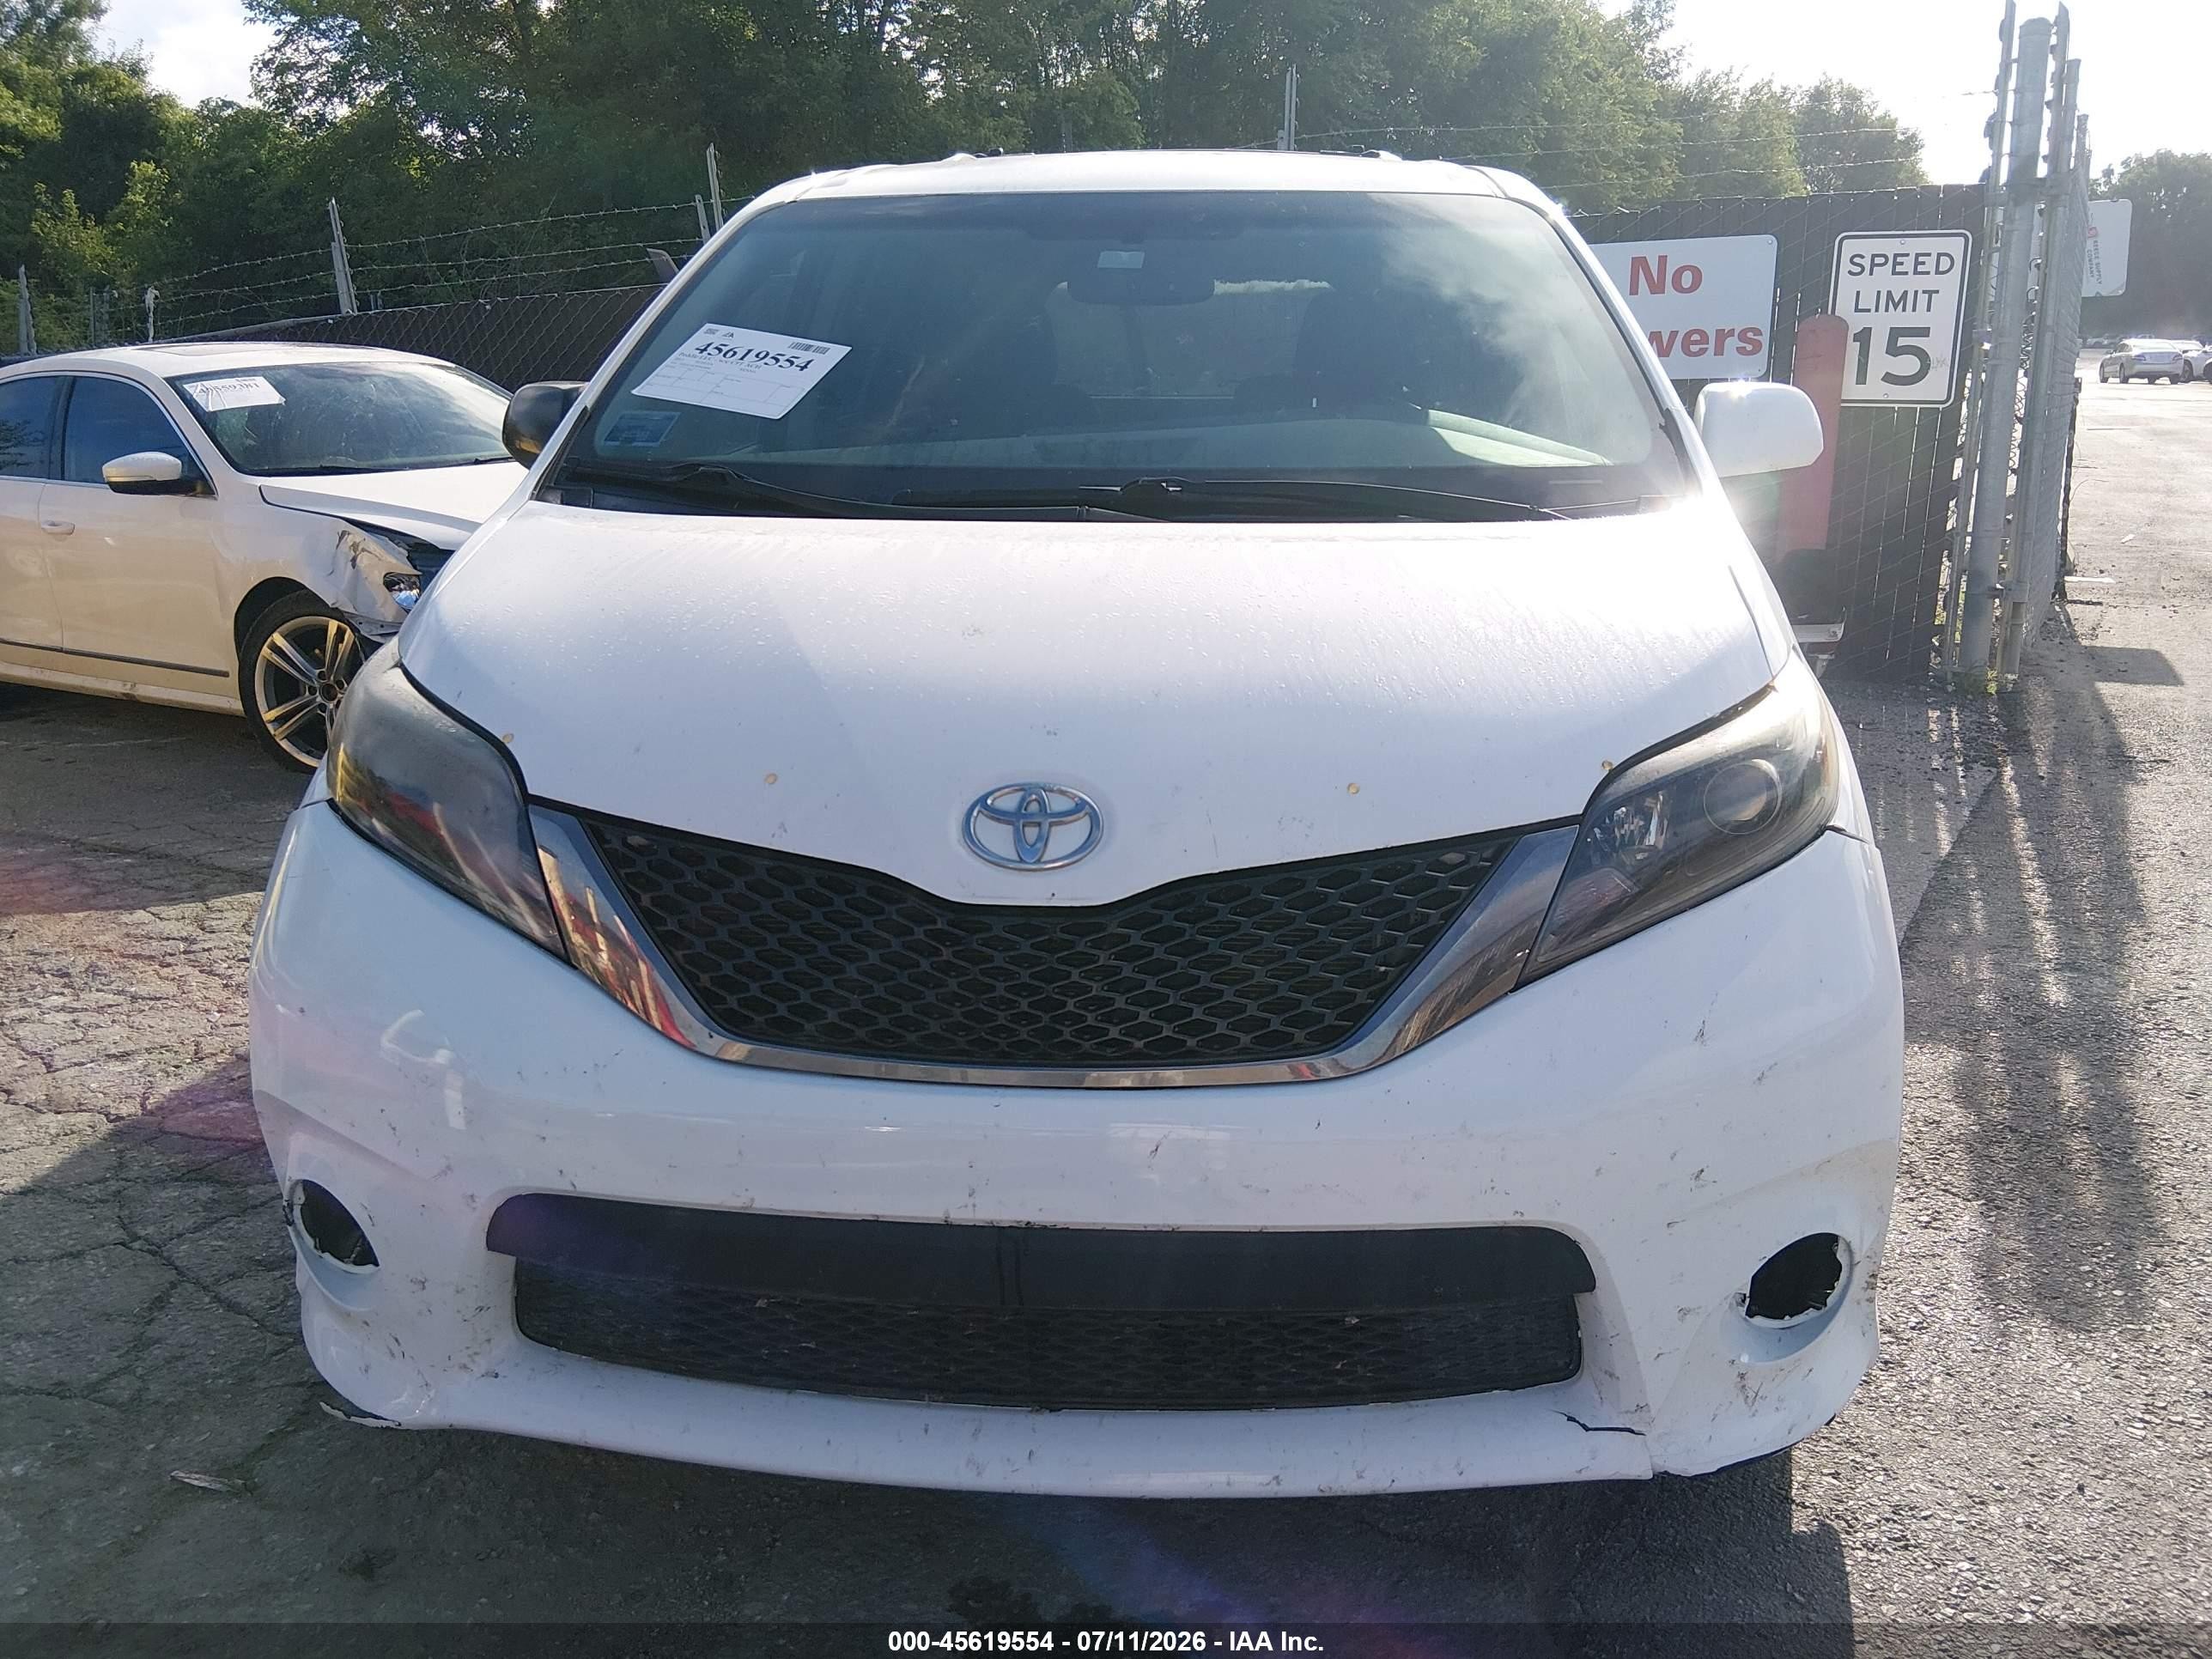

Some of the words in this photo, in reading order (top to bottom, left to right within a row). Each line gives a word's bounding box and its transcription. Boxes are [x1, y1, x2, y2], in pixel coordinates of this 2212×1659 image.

[1629, 255, 1703, 296] No
[1847, 252, 1955, 276] SPEED
[1854, 289, 1940, 313] LIMIT
[695, 342, 815, 372] 45619554
[1852, 326, 1931, 386] 15
